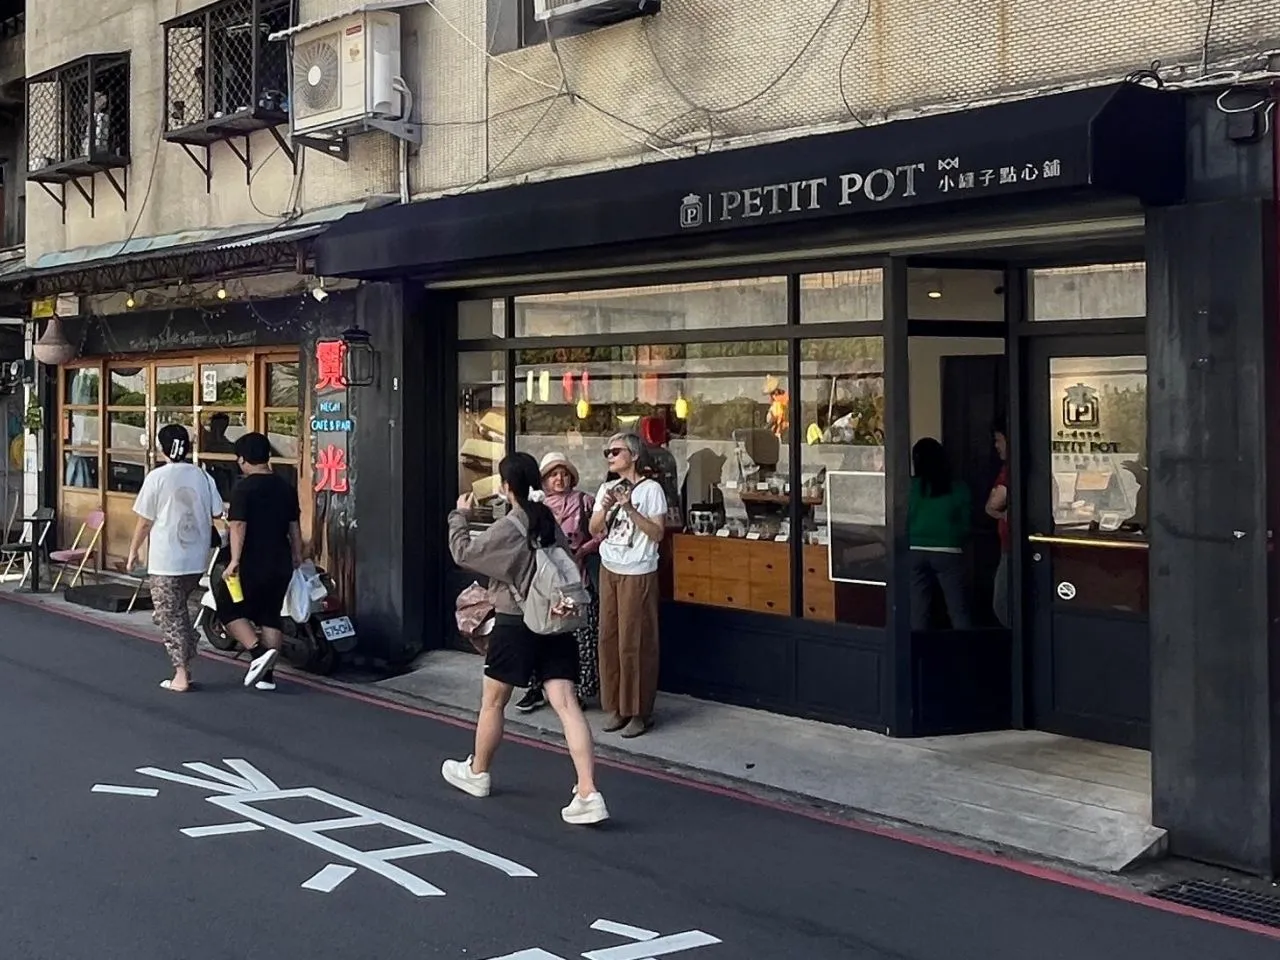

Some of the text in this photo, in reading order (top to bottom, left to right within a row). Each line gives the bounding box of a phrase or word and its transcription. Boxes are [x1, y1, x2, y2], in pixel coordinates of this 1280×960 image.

[719, 163, 925, 220] PETIT POT
[314, 443, 347, 492] 光
[1052, 440, 1121, 454] ETIT POT
